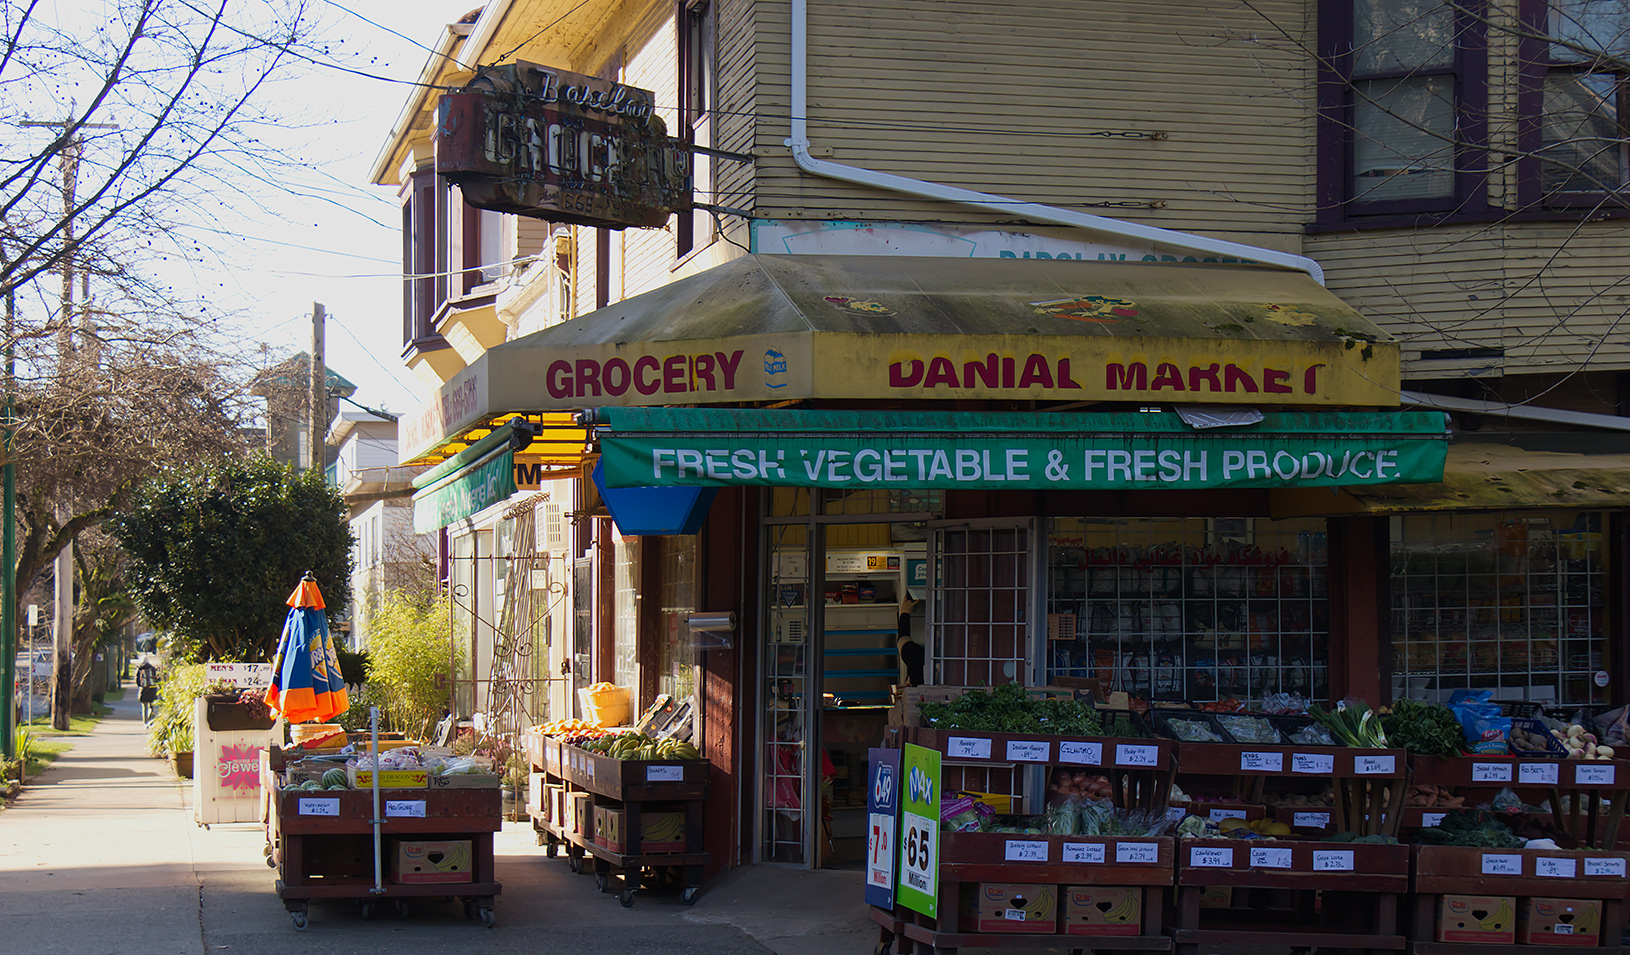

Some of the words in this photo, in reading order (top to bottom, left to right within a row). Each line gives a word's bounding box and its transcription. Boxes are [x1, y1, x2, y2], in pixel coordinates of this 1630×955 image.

[546, 350, 744, 399] GROCERY
[889, 353, 1082, 389] DANIAL
[653, 449, 785, 480] FRESH
[801, 449, 1030, 482] VEGETABLE
[1045, 449, 1070, 481] &
[1085, 450, 1208, 482] FRESH
[1223, 450, 1400, 482] PRODUCE
[908, 872, 927, 891] Million
